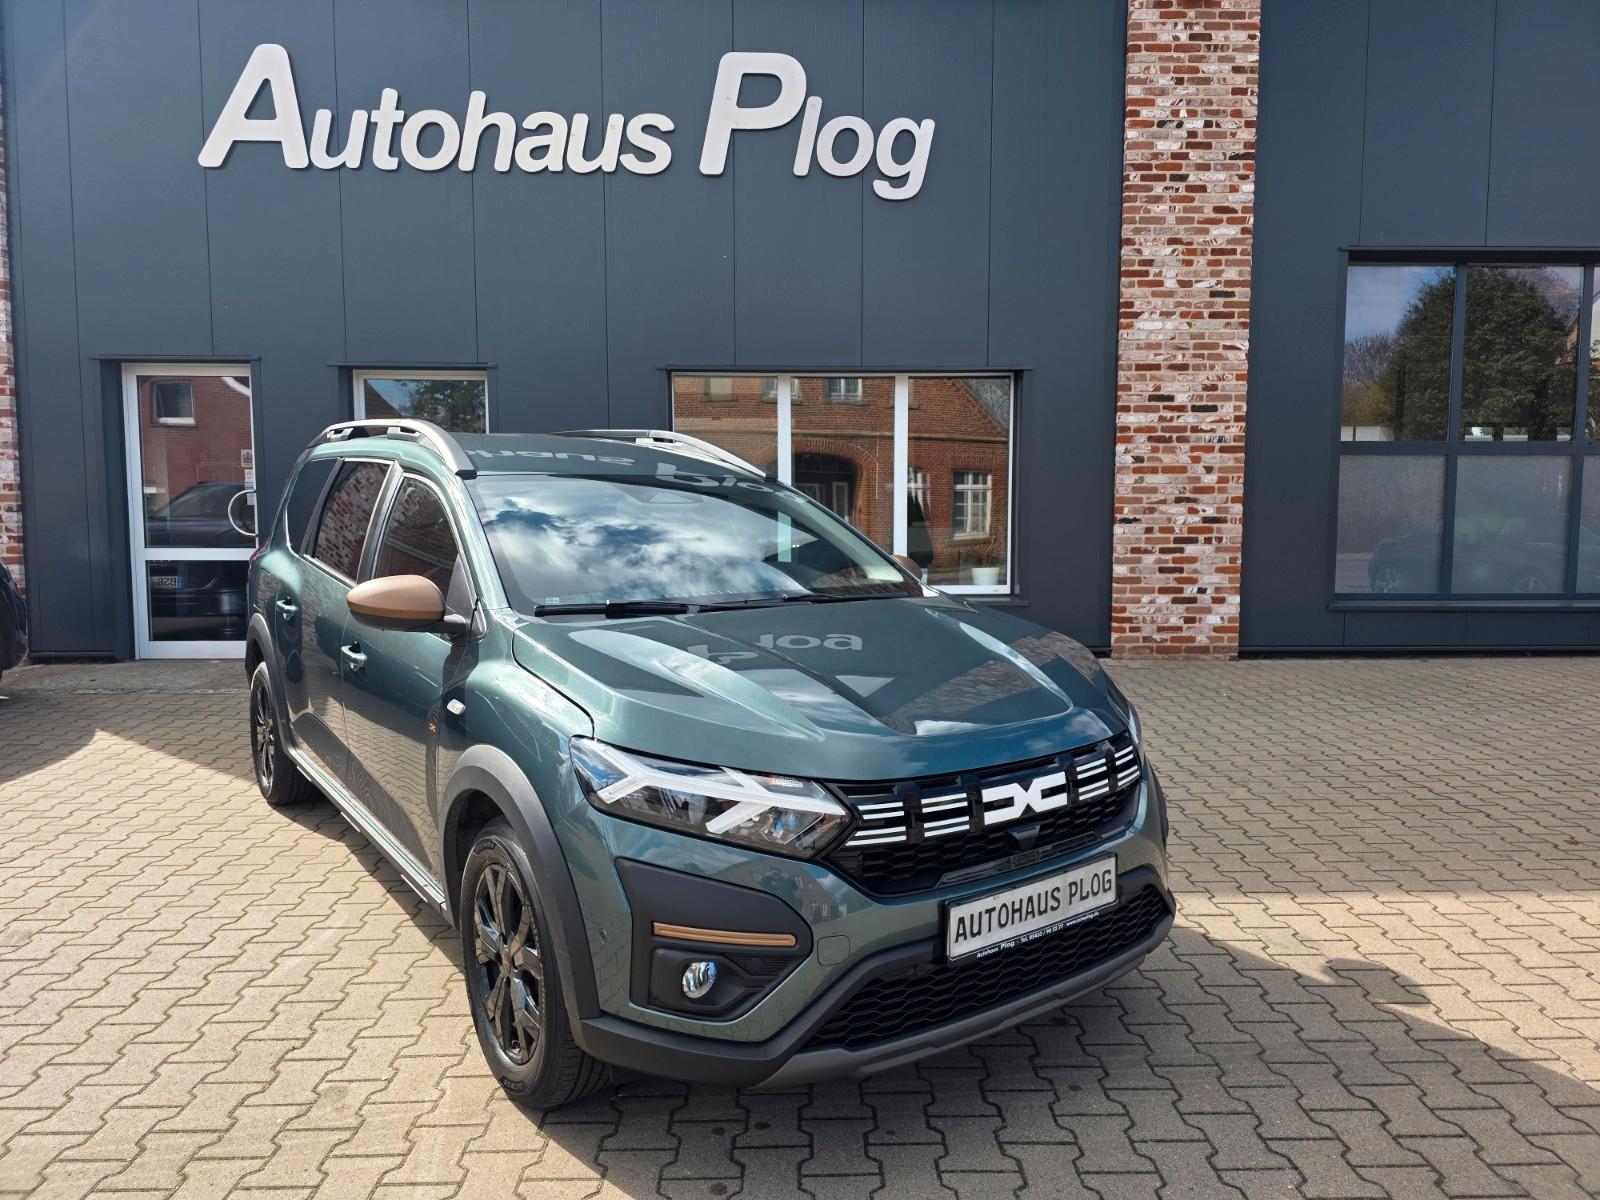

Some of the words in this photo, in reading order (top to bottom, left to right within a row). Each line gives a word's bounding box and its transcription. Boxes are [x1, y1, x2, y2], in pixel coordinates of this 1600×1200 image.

[197, 43, 675, 174] Autohaus
[699, 51, 936, 201] Plog
[954, 887, 1061, 943] AUTOHAUS
[1068, 868, 1112, 906] PLOG
[1000, 940, 1015, 950] Plog
